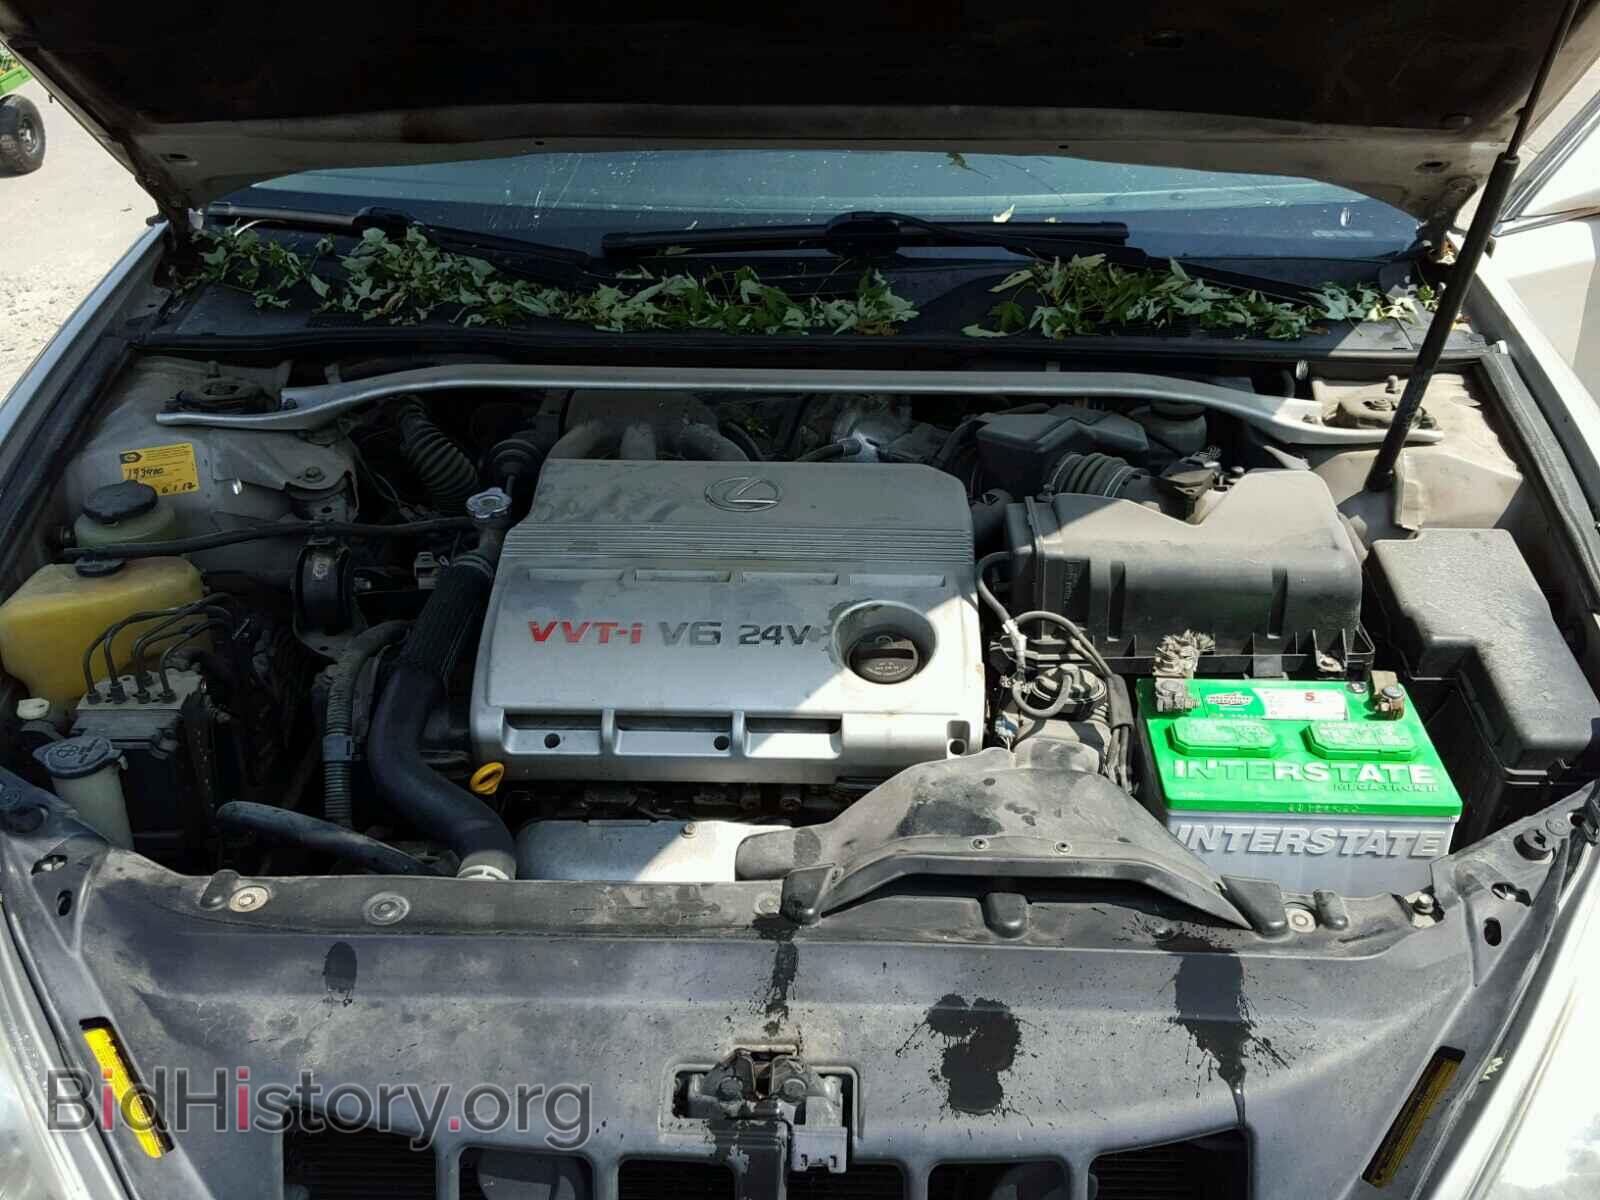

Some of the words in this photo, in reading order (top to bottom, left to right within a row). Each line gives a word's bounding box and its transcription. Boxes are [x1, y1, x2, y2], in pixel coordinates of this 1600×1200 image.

[527, 621, 645, 646] VVT-i
[657, 621, 723, 647] V6
[738, 624, 813, 647] 24V
[1173, 759, 1439, 785] INTERSTATE
[1176, 823, 1447, 859] INTERSTATE
